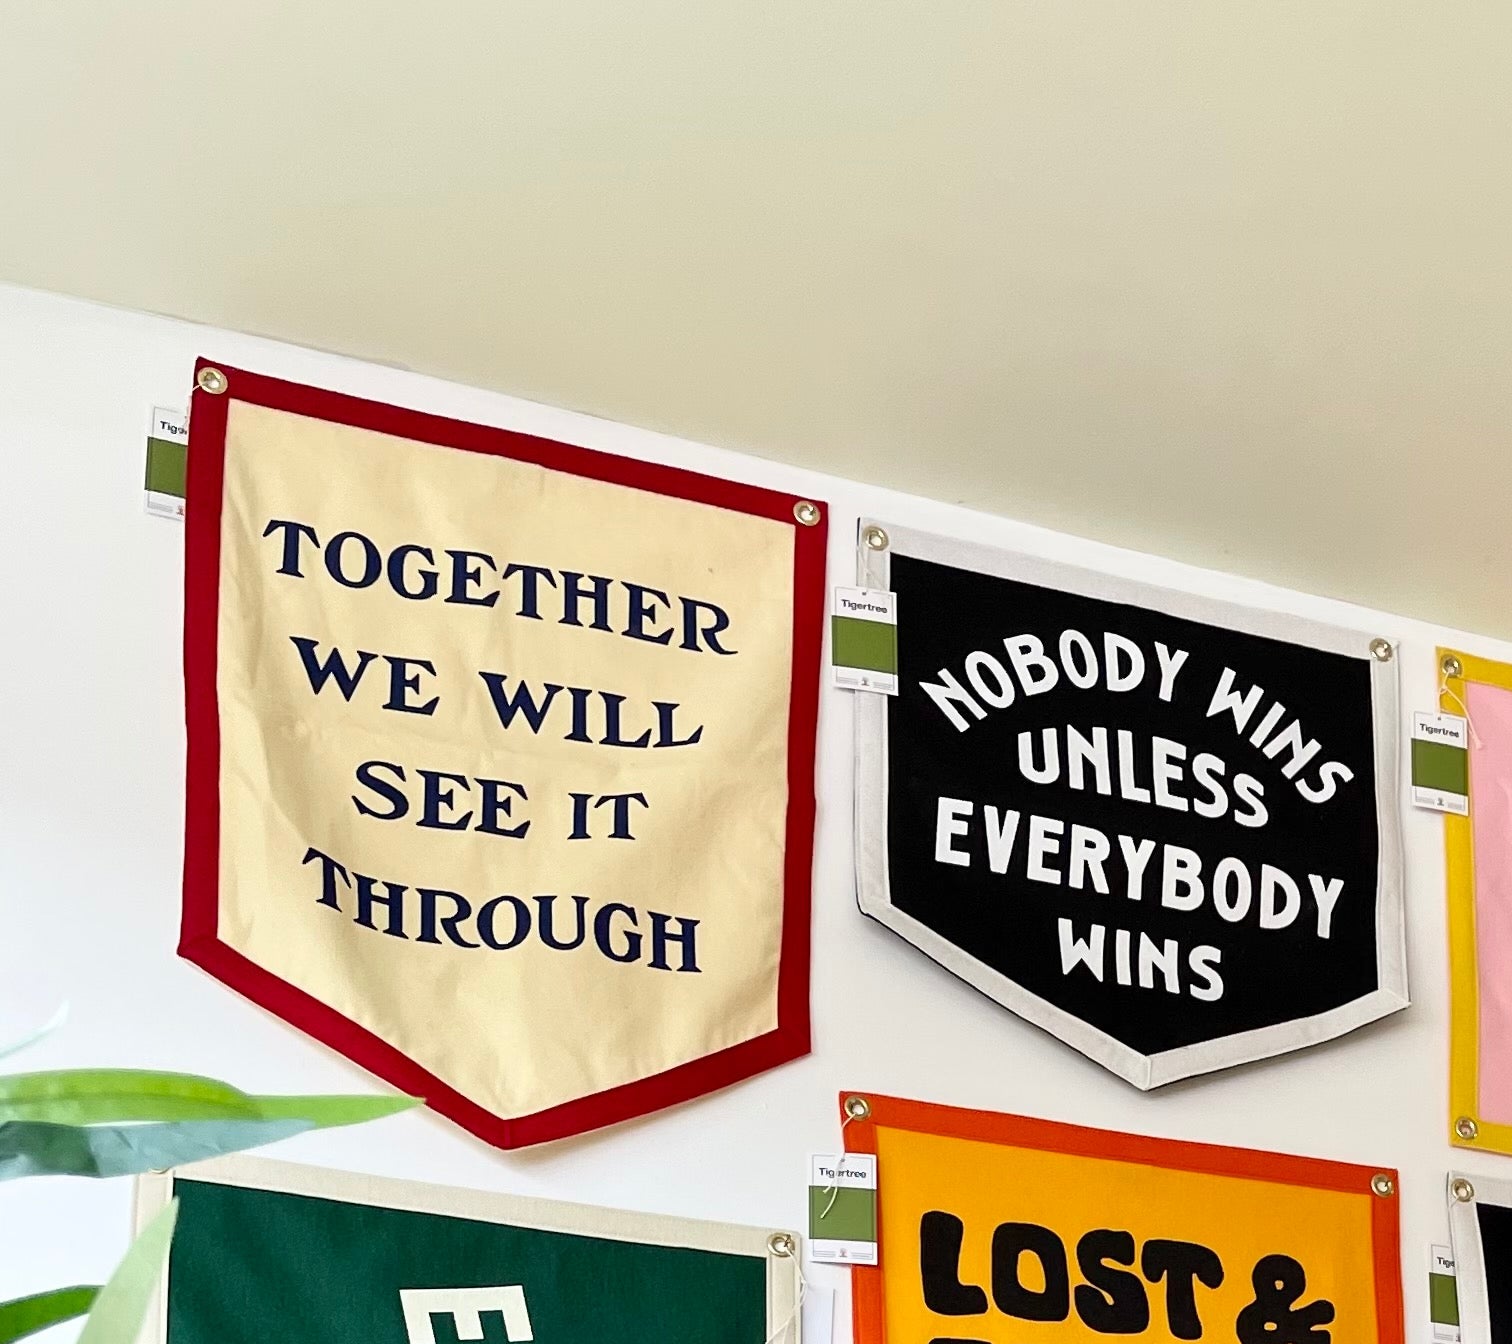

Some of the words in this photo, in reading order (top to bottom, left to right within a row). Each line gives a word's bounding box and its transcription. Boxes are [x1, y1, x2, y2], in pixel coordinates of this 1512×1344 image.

[263, 519, 738, 655] TOGETHER
[841, 599, 888, 614] Tigertree
[290, 636, 440, 716] WE
[478, 672, 704, 749] WILL
[919, 629, 1189, 732] NOBODY
[1206, 667, 1354, 803] WINS
[1419, 723, 1460, 738] Tigertree
[351, 761, 530, 840] SEE
[568, 792, 649, 841] IT
[1018, 724, 1269, 828] UNLESS
[302, 848, 702, 973] THROUGH
[935, 797, 1344, 939] EVERYBODY
[1058, 918, 1224, 1002] WINS
[819, 1168, 867, 1179] Tigrtree
[919, 1210, 1224, 1341] LOST
